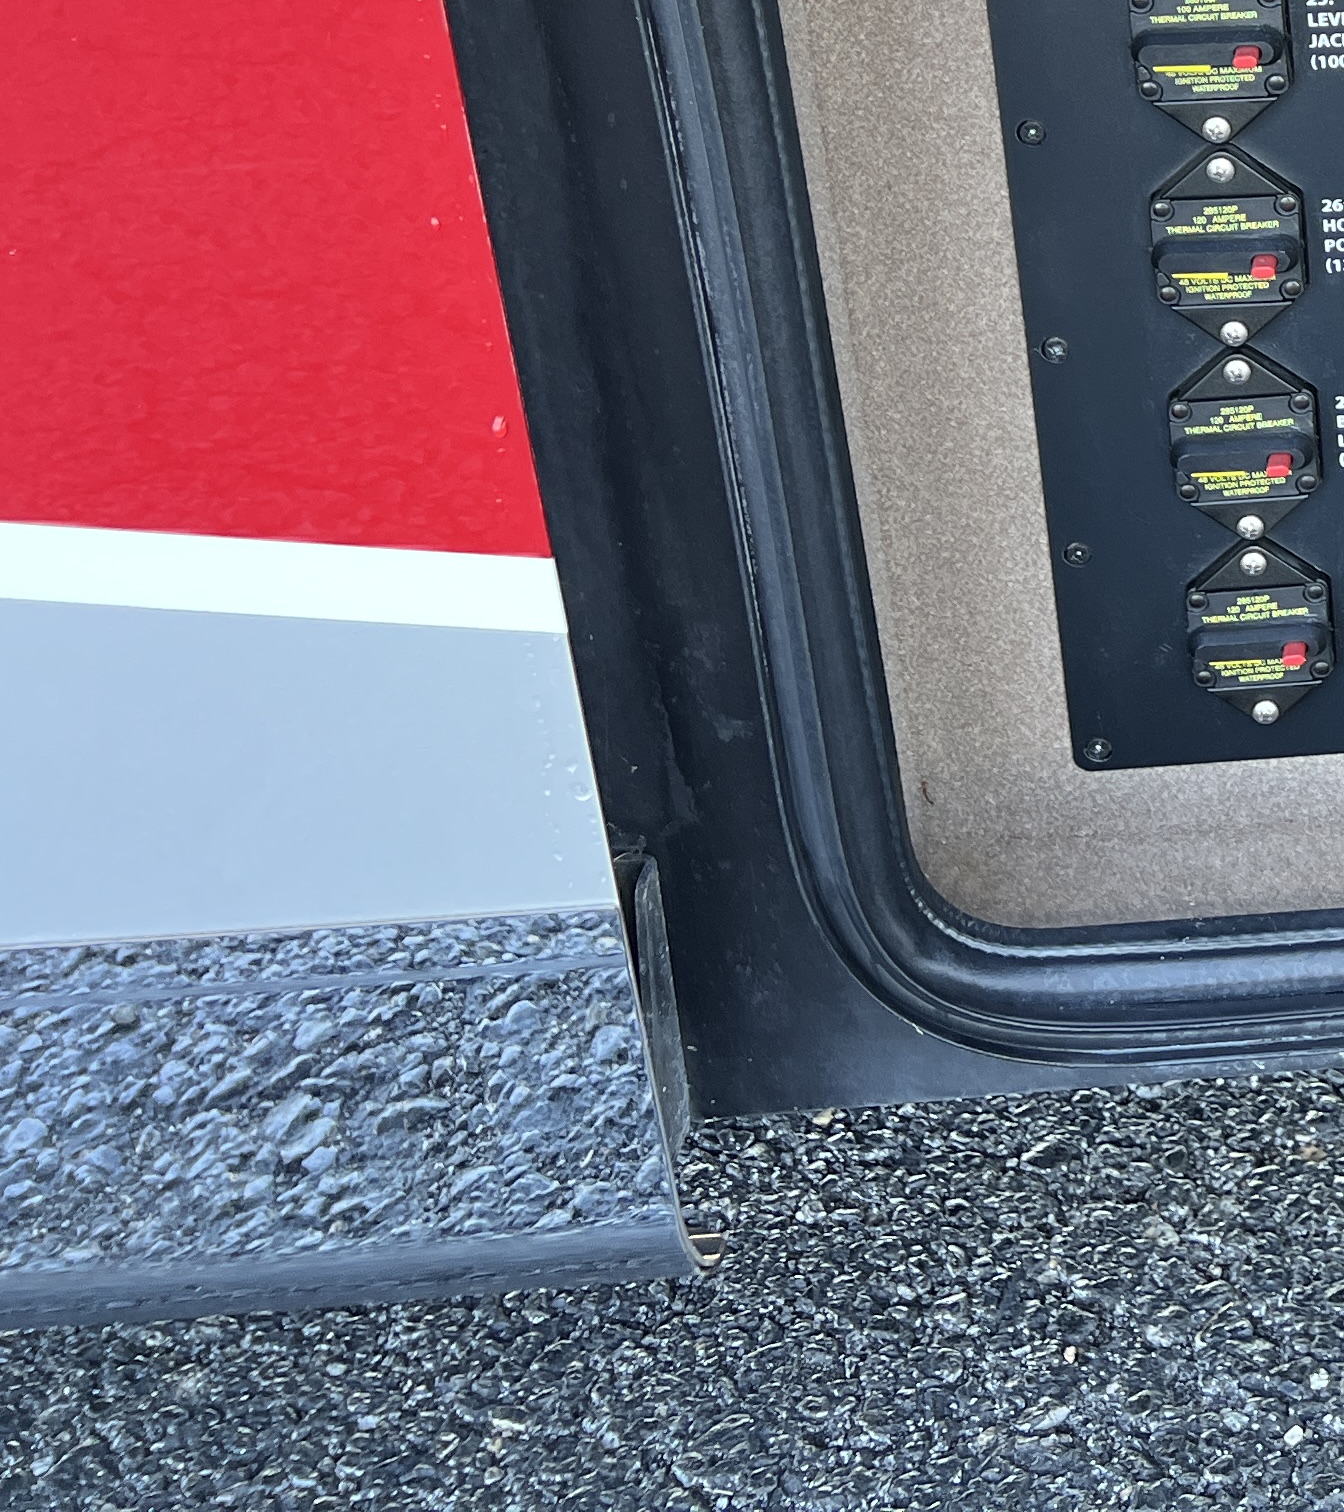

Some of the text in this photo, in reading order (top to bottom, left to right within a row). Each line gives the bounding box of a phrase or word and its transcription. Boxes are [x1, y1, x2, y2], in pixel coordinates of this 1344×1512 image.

[1193, 4, 1230, 13] AMPERE
[1150, 11, 1258, 24] THERMAL CIRCUIT BREAKER
[1175, 74, 1256, 86] IGNITION PROTECTED
[1192, 83, 1240, 94] WATERPROOF
[1192, 214, 1247, 225] 120 AMPERE
[1166, 220, 1280, 235] THERMAL CIRCUIT BREAKER
[1185, 282, 1270, 294] IGNITION PROTECTED
[1204, 290, 1253, 301] WATERPROOF
[1210, 413, 1263, 425] 120 AMPERE
[1184, 418, 1295, 435] THERMAL CIRCUIT BREAKER
[1205, 478, 1287, 491] IGNITION PROTECTED
[1246, 602, 1278, 612] AMPERE
[1202, 607, 1309, 624] THERMAL CIRCUIT BREAKER
